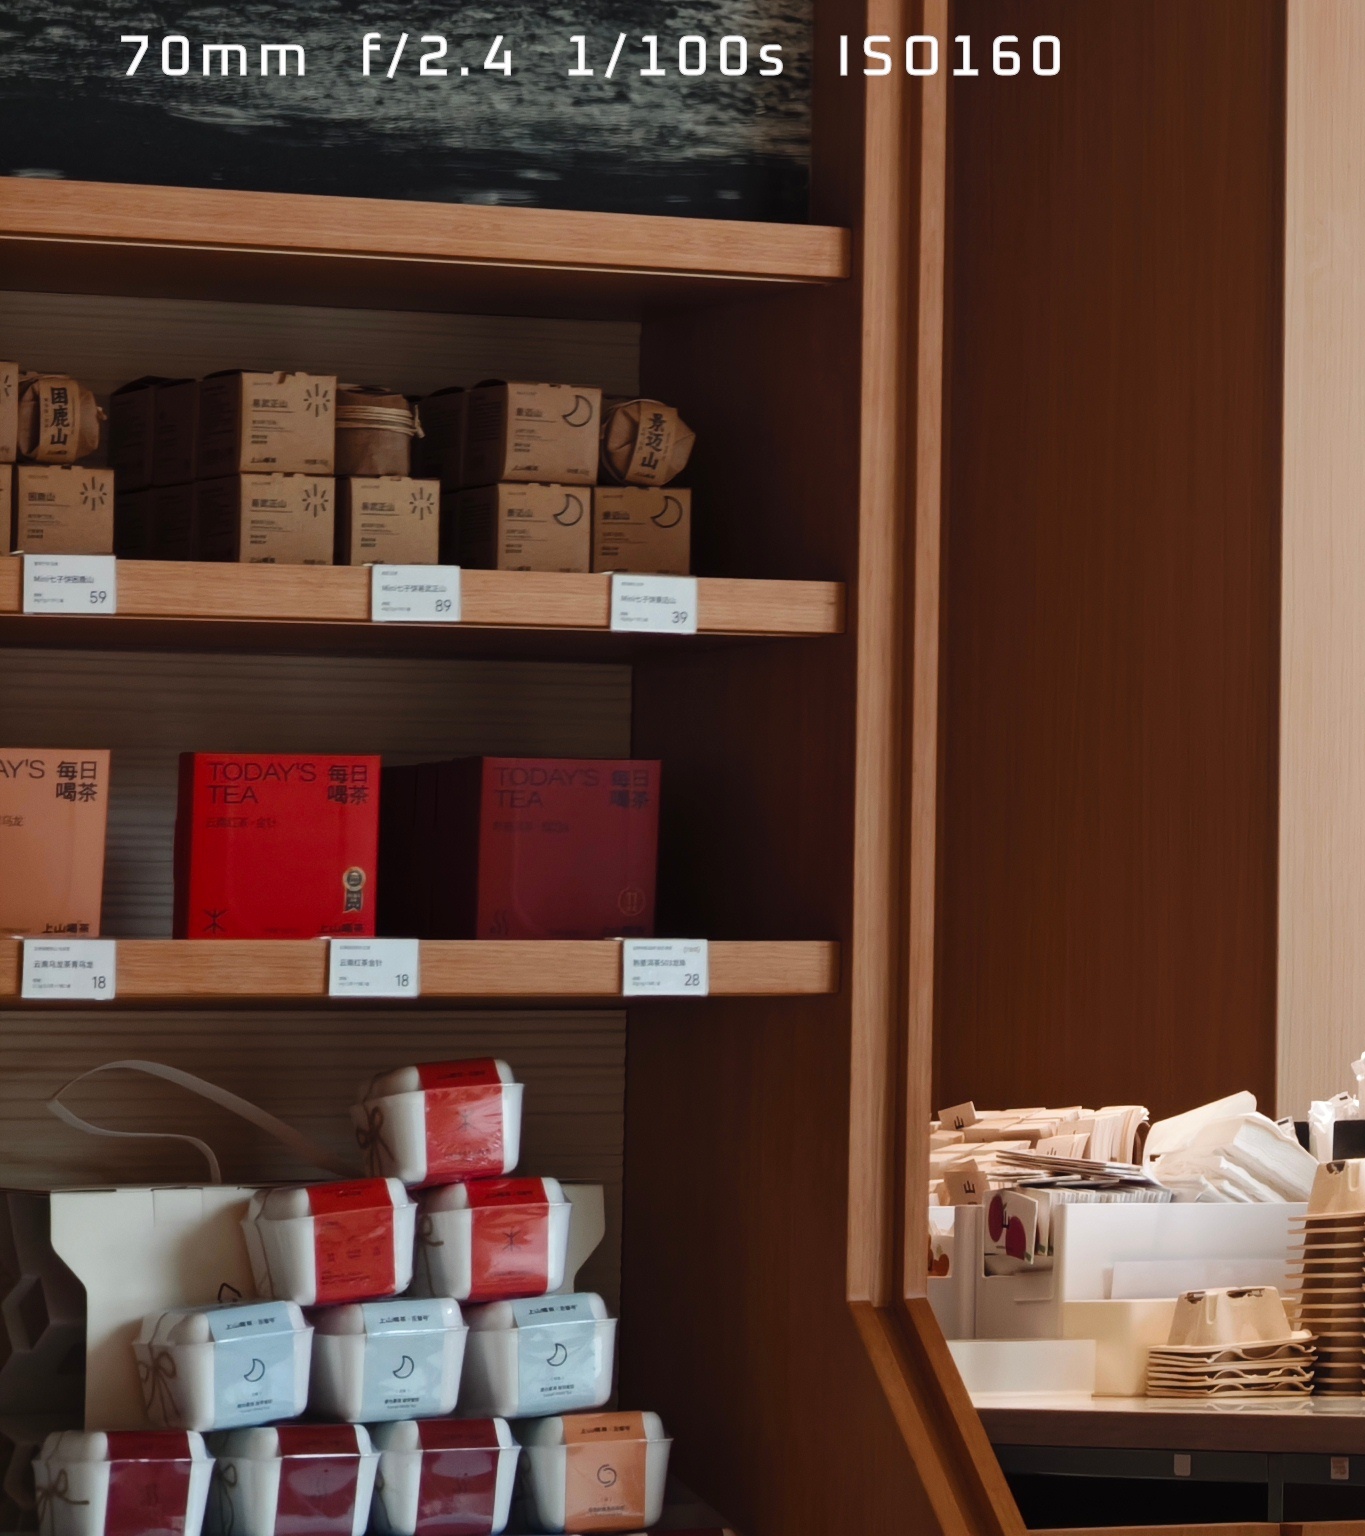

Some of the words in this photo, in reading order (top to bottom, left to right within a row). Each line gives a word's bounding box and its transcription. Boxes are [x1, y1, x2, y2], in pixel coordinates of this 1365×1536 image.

[50, 387, 70, 446] 困鹿山
[641, 413, 666, 471] 景迈山
[89, 590, 107, 604] 59
[435, 599, 452, 612] 89
[671, 611, 689, 624] 39
[56, 760, 97, 780] 每日
[207, 762, 317, 782] TODAY'S
[328, 764, 369, 784] 每日
[494, 766, 600, 787] TODAY'S
[55, 782, 98, 803] 喝茶
[207, 784, 259, 804] TEA
[327, 785, 369, 805] 喝茶
[494, 789, 544, 809] TEA
[91, 975, 107, 989] 18
[394, 973, 409, 987] 18
[684, 973, 700, 987] 28
